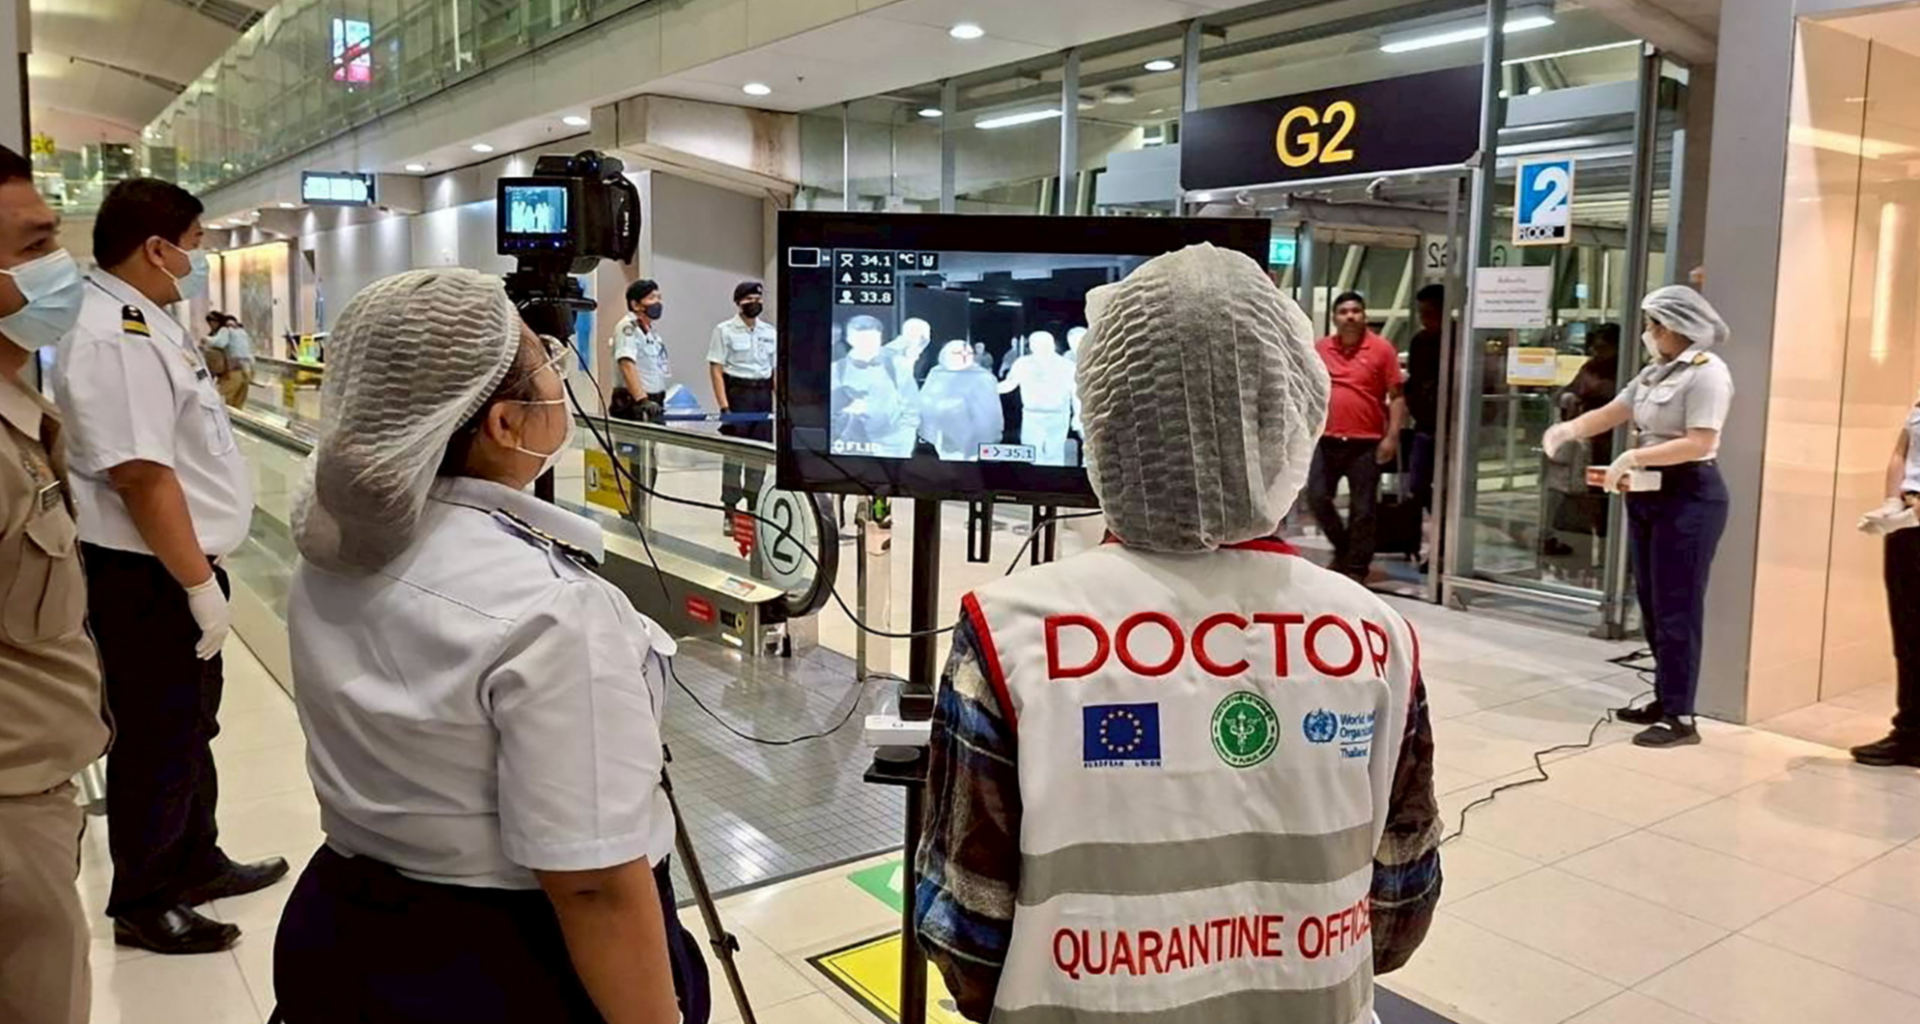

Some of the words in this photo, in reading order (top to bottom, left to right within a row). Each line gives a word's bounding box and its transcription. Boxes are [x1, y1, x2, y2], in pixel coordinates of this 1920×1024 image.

[1276, 101, 1356, 167] G2
[1530, 166, 1569, 226] 2
[860, 254, 891, 266] 34.1
[860, 272, 891, 284] 35.1
[860, 291, 892, 303] 33.8
[1004, 447, 1033, 459] 35.1
[772, 497, 794, 564] 2
[1044, 612, 1389, 680] DOCTOR
[1340, 712, 1365, 725] World
[1053, 915, 1284, 980] QUARANTINE
